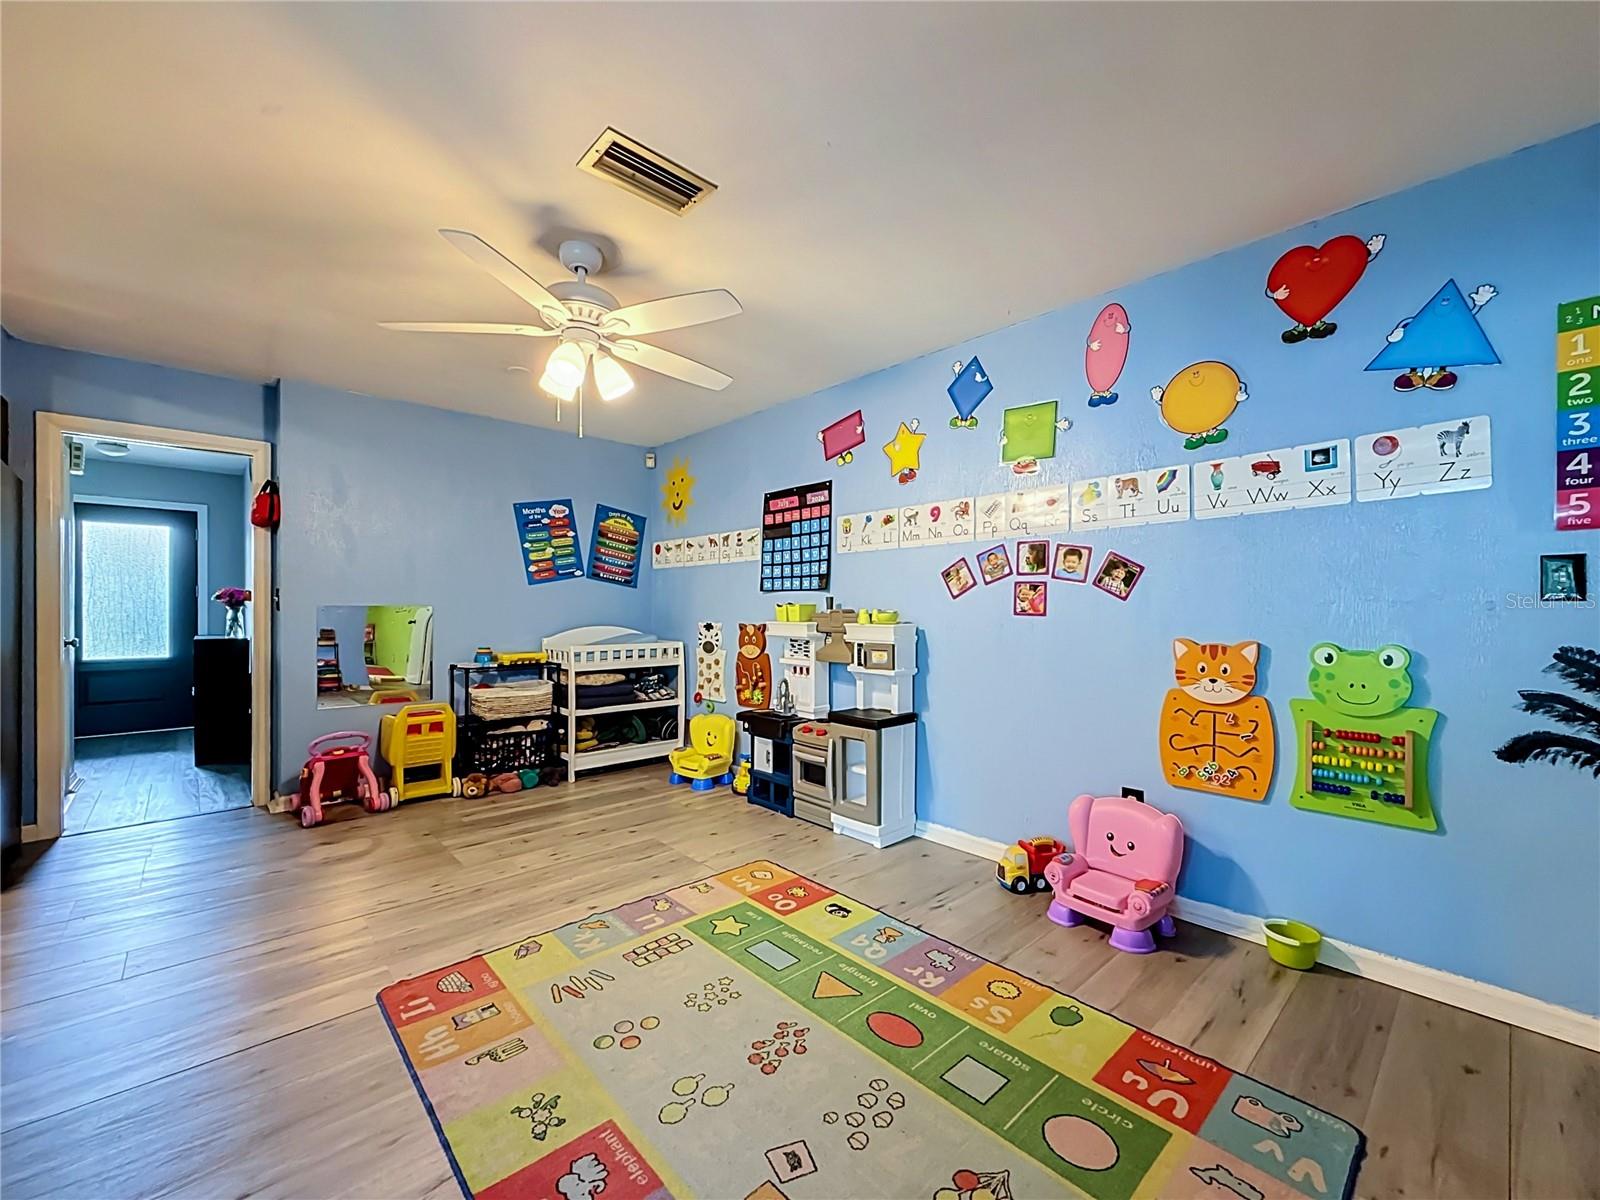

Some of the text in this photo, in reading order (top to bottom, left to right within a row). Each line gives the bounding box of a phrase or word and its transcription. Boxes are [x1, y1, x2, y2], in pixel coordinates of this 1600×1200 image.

[1565, 316, 1572, 324] 2
[1570, 333, 1590, 356] 1
[1566, 356, 1592, 366] one
[1569, 372, 1592, 396] 2
[1567, 397, 1593, 406] two
[1568, 412, 1590, 436] 3
[1562, 436, 1598, 446] three
[1566, 452, 1592, 474] 4
[1374, 462, 1472, 496] Yy Zz
[1566, 477, 1594, 486] four
[1207, 480, 1337, 508] Vv Ww Xx
[1568, 492, 1590, 516] 5
[522, 507, 546, 515] Months
[1082, 500, 1180, 522] Ss Tt Uu
[1567, 516, 1592, 525] five
[608, 532, 628, 543] Monday
[902, 524, 968, 542] Mm Nn Oo
[983, 521, 998, 538] Pp
[1009, 518, 1030, 534] Qq
[606, 541, 628, 550] Tuesday
[842, 532, 892, 551] Jj Kk Ll
[768, 894, 797, 910] Oo
[781, 930, 824, 956] rectangle
[851, 934, 888, 959] Qq
[838, 962, 879, 988] triangle
[904, 966, 945, 988] Rr
[400, 996, 436, 1020] Ii
[908, 1002, 937, 1020] oval
[969, 996, 1012, 1025] Ss
[978, 1040, 1032, 1073] square
[1141, 1034, 1218, 1074] umbrella
[1121, 1070, 1189, 1119] Uu
[1081, 1097, 1134, 1130] circle
[598, 1127, 648, 1185] elephant
[1252, 1138, 1328, 1193] Vv
